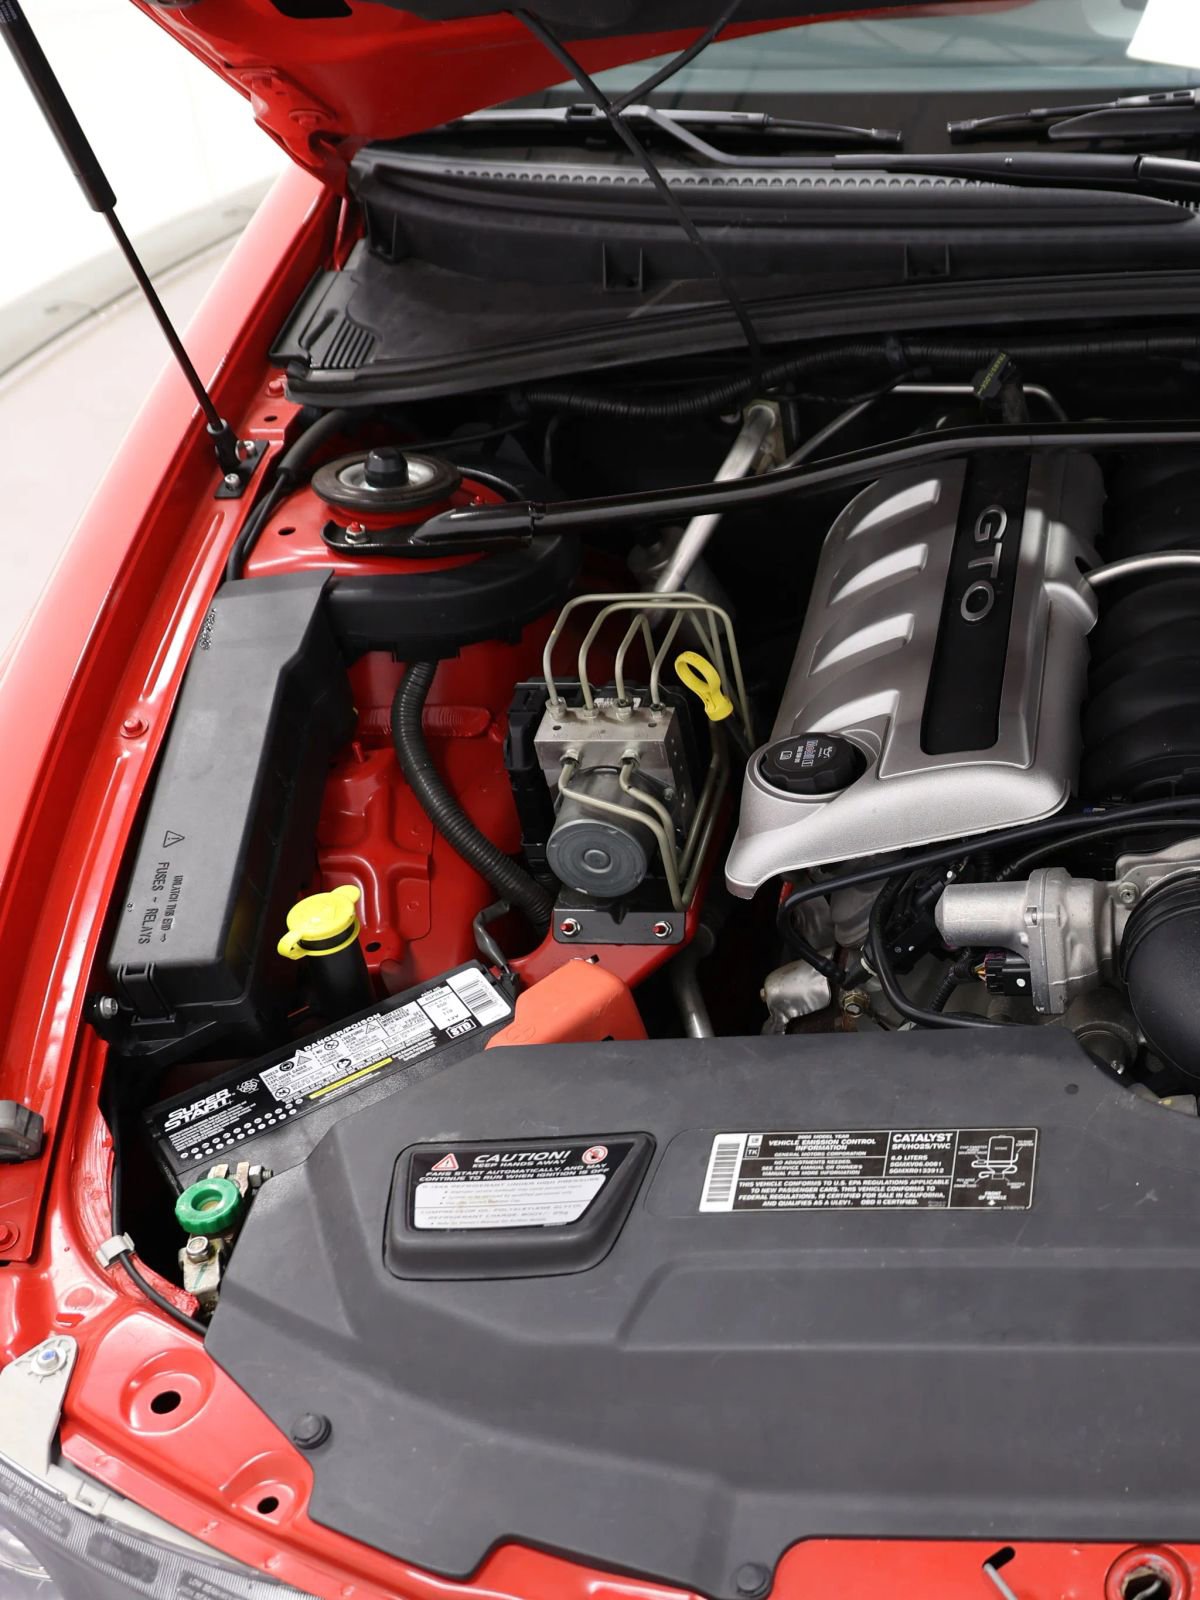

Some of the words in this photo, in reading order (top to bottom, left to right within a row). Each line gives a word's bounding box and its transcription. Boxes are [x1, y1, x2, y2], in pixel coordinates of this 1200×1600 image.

[961, 505, 1007, 621] GTO
[152, 862, 170, 891] FUSES
[169, 875, 183, 902] UNLATCH
[138, 909, 159, 944] RELAYS
[303, 1012, 381, 1052] DANGER/POISON
[450, 1022, 471, 1035] STD
[164, 1093, 231, 1132] START
[168, 1088, 230, 1119] SUPER
[892, 1133, 953, 1142] CATALYST
[474, 1151, 571, 1163] CAUTION!
